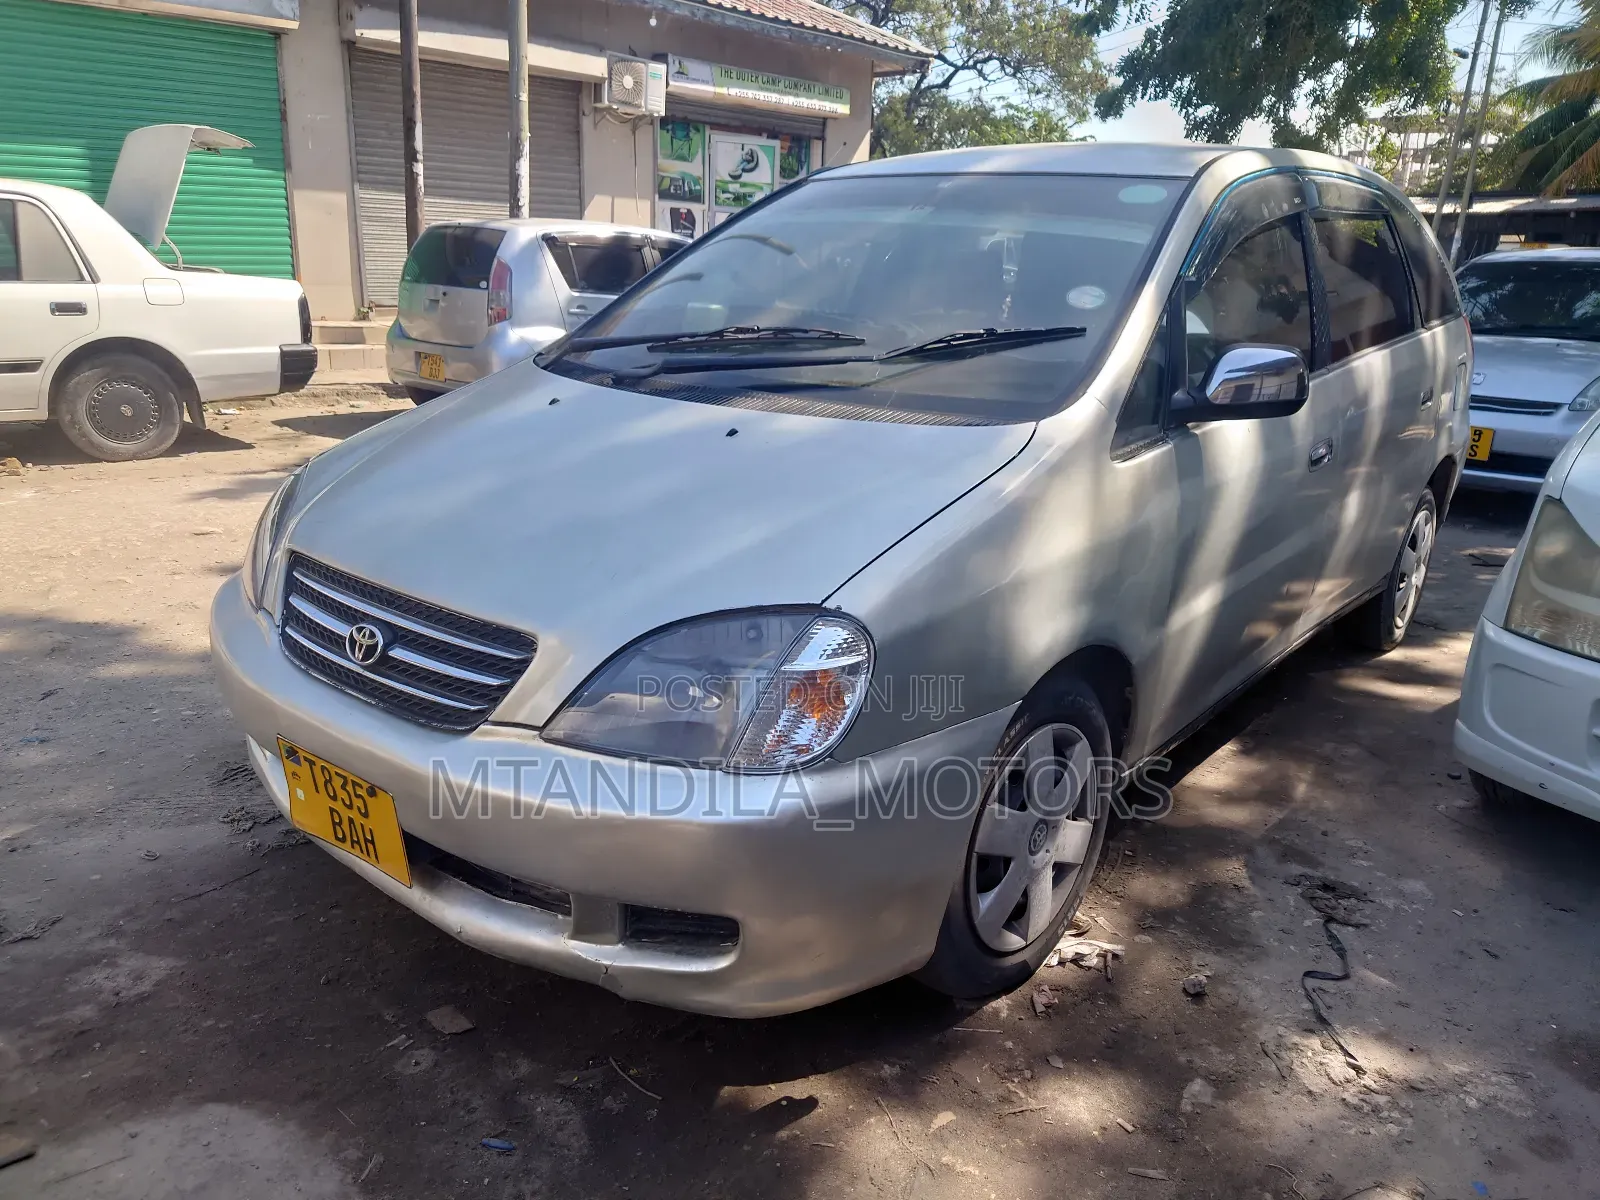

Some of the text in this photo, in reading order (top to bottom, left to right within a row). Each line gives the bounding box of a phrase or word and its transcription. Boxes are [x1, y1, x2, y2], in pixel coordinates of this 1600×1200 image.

[720, 67, 734, 80] THE
[736, 70, 760, 85] OUTER
[761, 75, 781, 88] CAMP
[783, 79, 816, 94] COMPANY
[818, 84, 844, 100] LIMITED
[303, 754, 370, 819] T835
[328, 804, 380, 865] BAH
